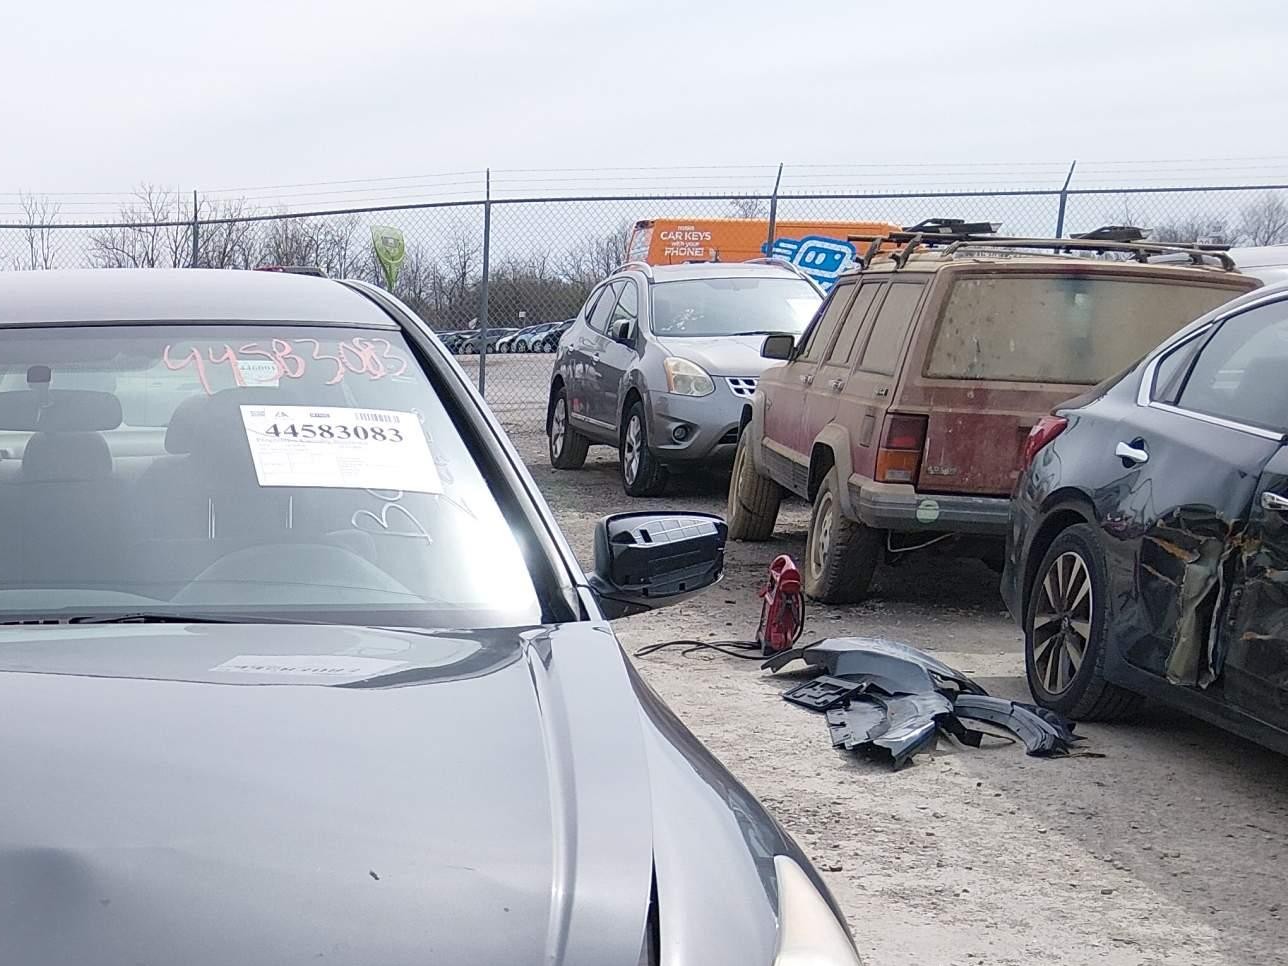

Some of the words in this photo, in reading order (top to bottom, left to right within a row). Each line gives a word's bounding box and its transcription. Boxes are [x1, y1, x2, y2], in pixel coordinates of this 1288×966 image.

[660, 231, 683, 241] CAR
[684, 231, 712, 241] KEYS
[162, 336, 409, 396] 44583083
[264, 423, 405, 443] 44583083
